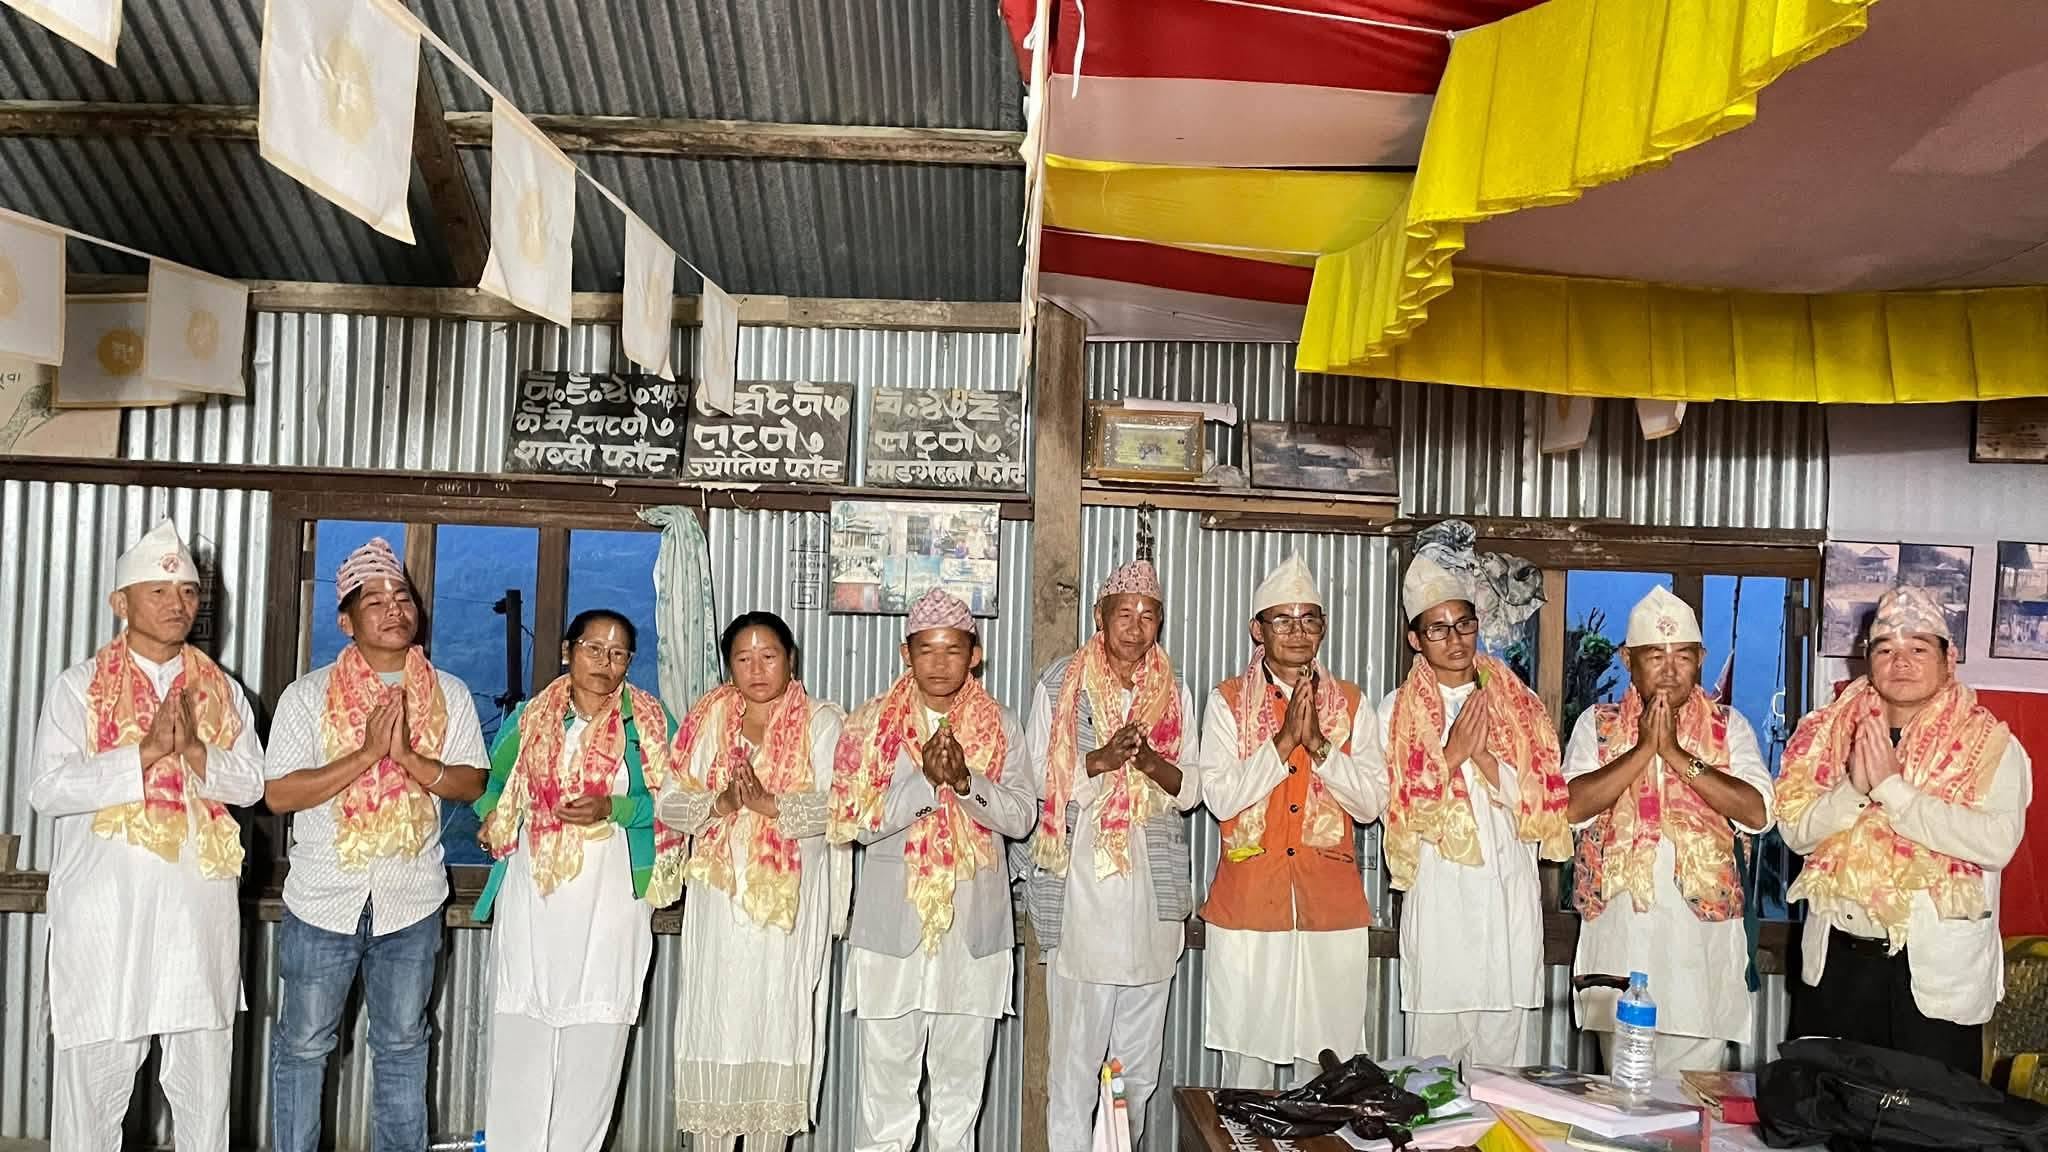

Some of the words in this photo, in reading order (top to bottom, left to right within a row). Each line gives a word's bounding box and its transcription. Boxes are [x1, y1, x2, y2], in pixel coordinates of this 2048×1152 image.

[600, 438, 679, 472] फाँट
[688, 450, 779, 477] ज्योतिष
[784, 454, 843, 478] फाँट
